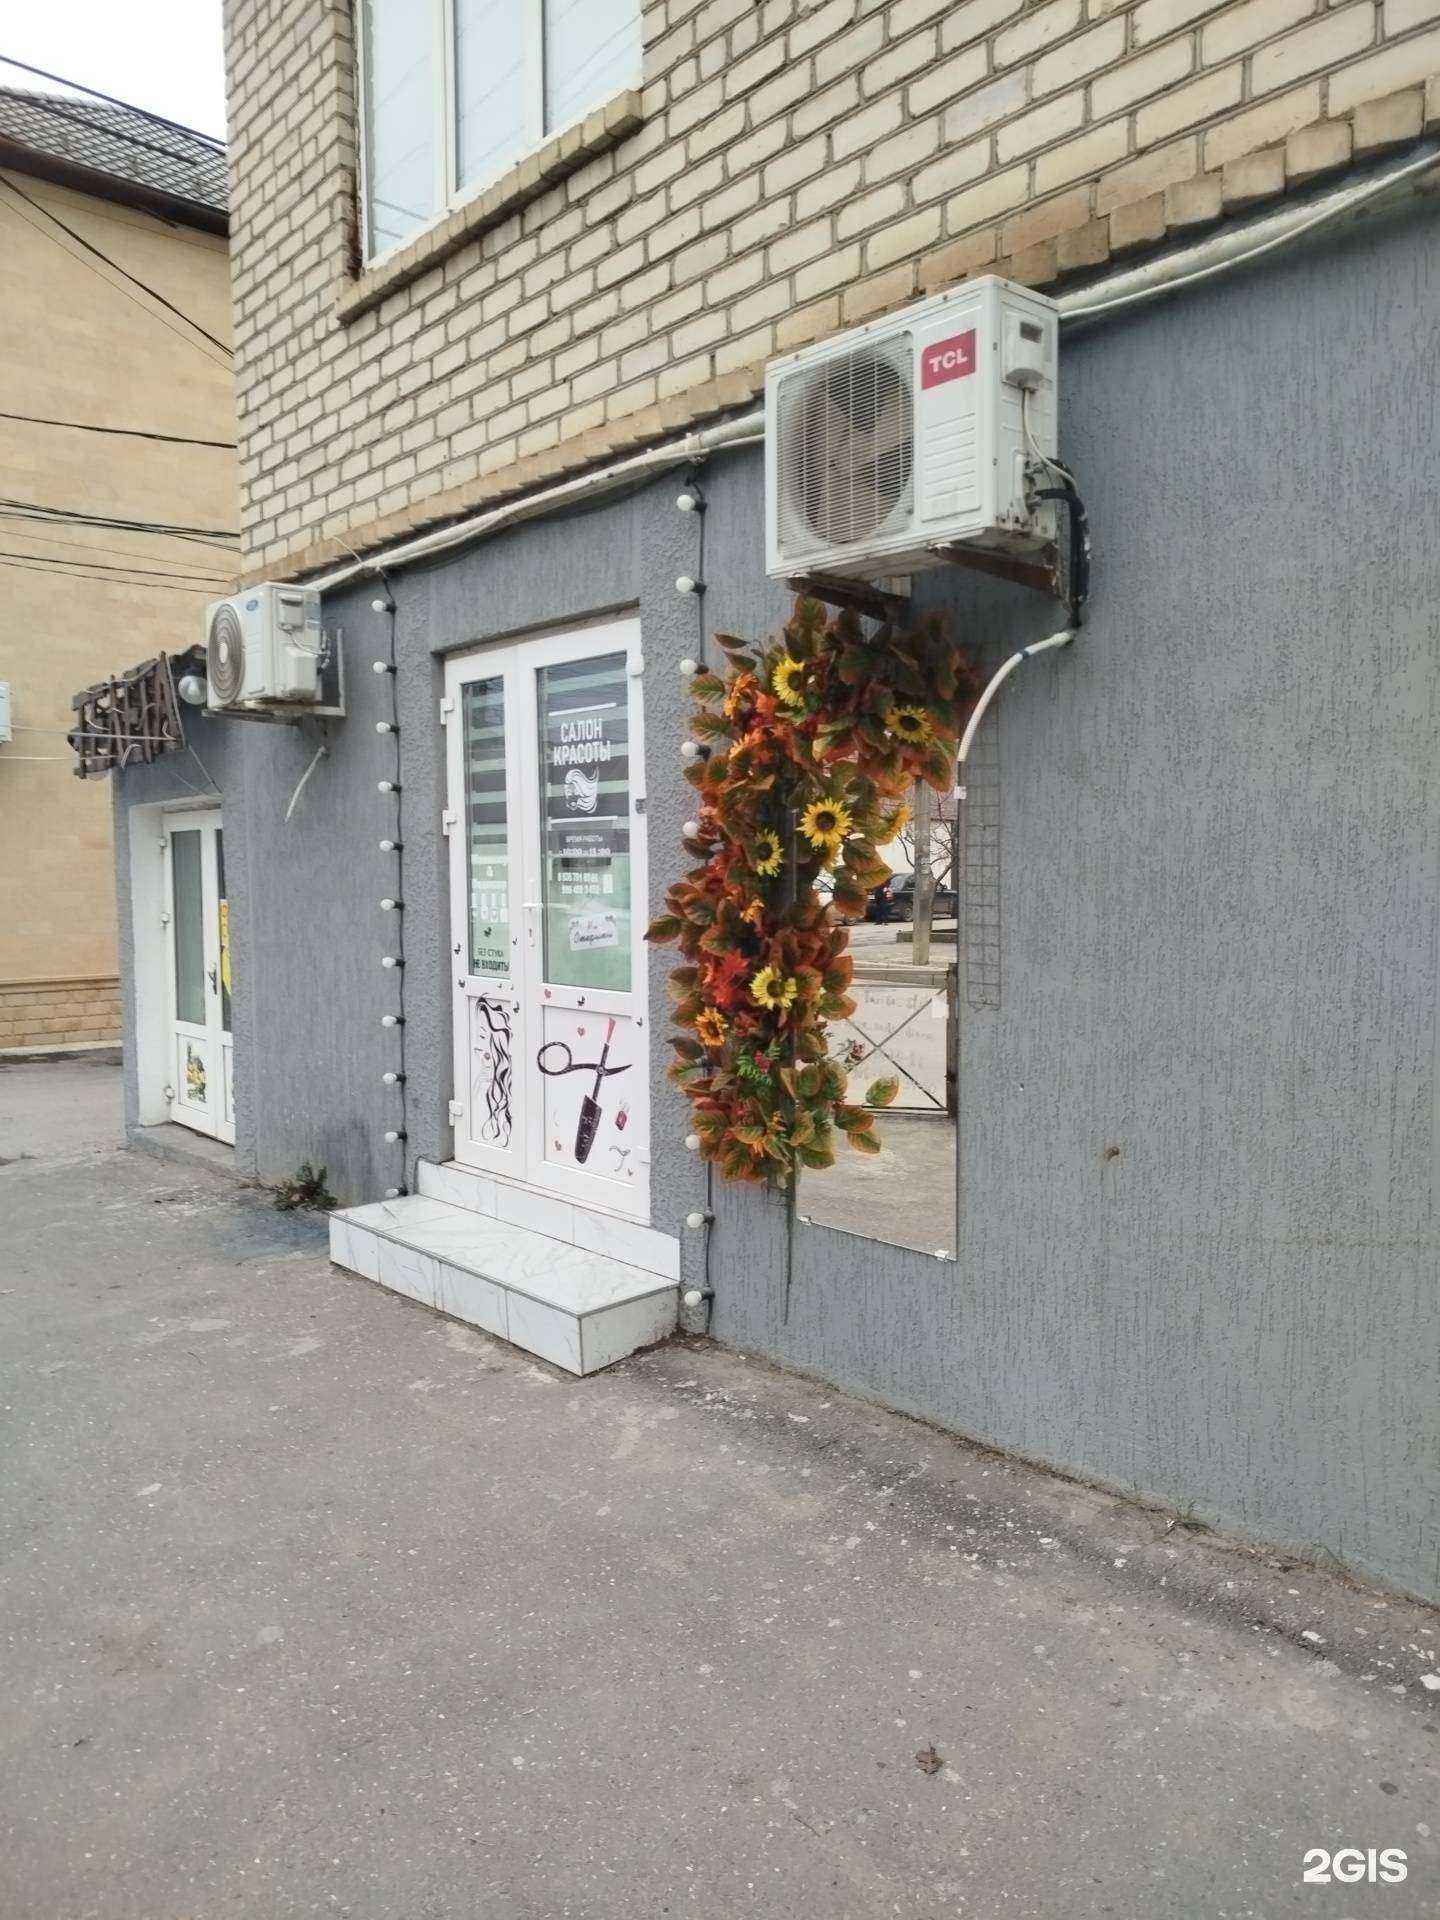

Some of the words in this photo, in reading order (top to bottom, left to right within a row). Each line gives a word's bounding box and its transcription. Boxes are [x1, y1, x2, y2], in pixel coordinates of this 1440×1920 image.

[928, 347, 968, 373] TCL
[560, 718, 602, 743] САЛОН
[553, 740, 611, 766] КРАСОТЫ
[472, 958, 481, 969] НЕ
